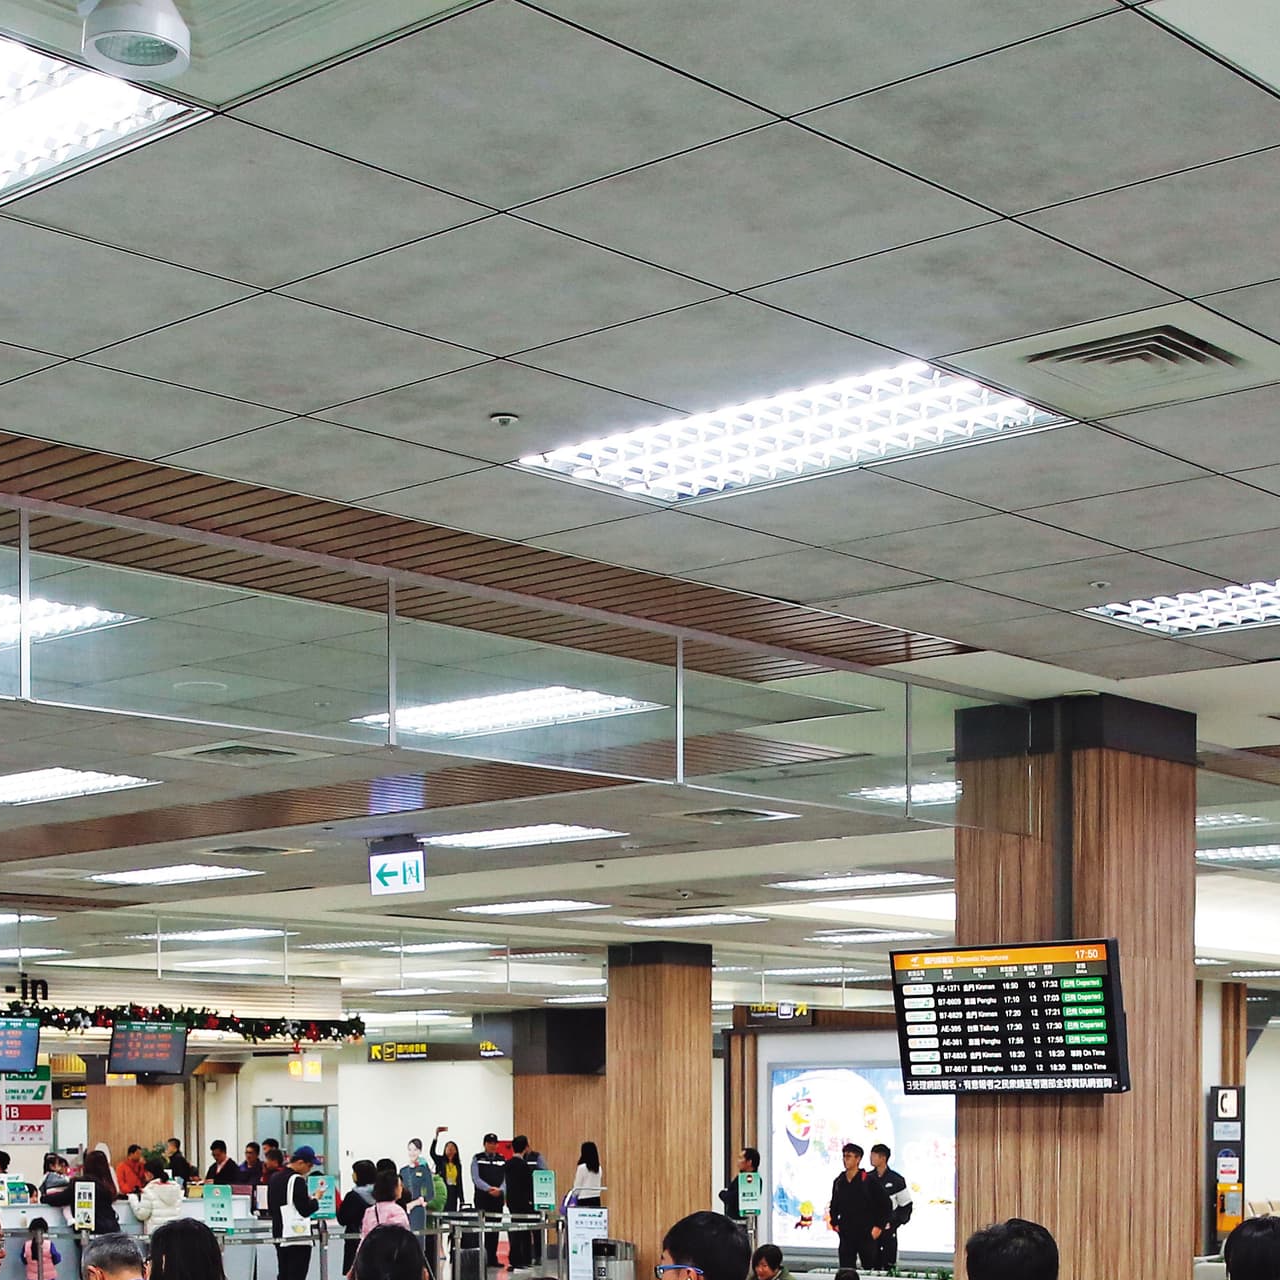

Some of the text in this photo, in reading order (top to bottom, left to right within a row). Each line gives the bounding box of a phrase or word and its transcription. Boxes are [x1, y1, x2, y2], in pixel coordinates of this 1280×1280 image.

[1075, 949, 1099, 959] 17:50
[1092, 1049, 1105, 1057] Time
[5, 1106, 20, 1118] 1B
